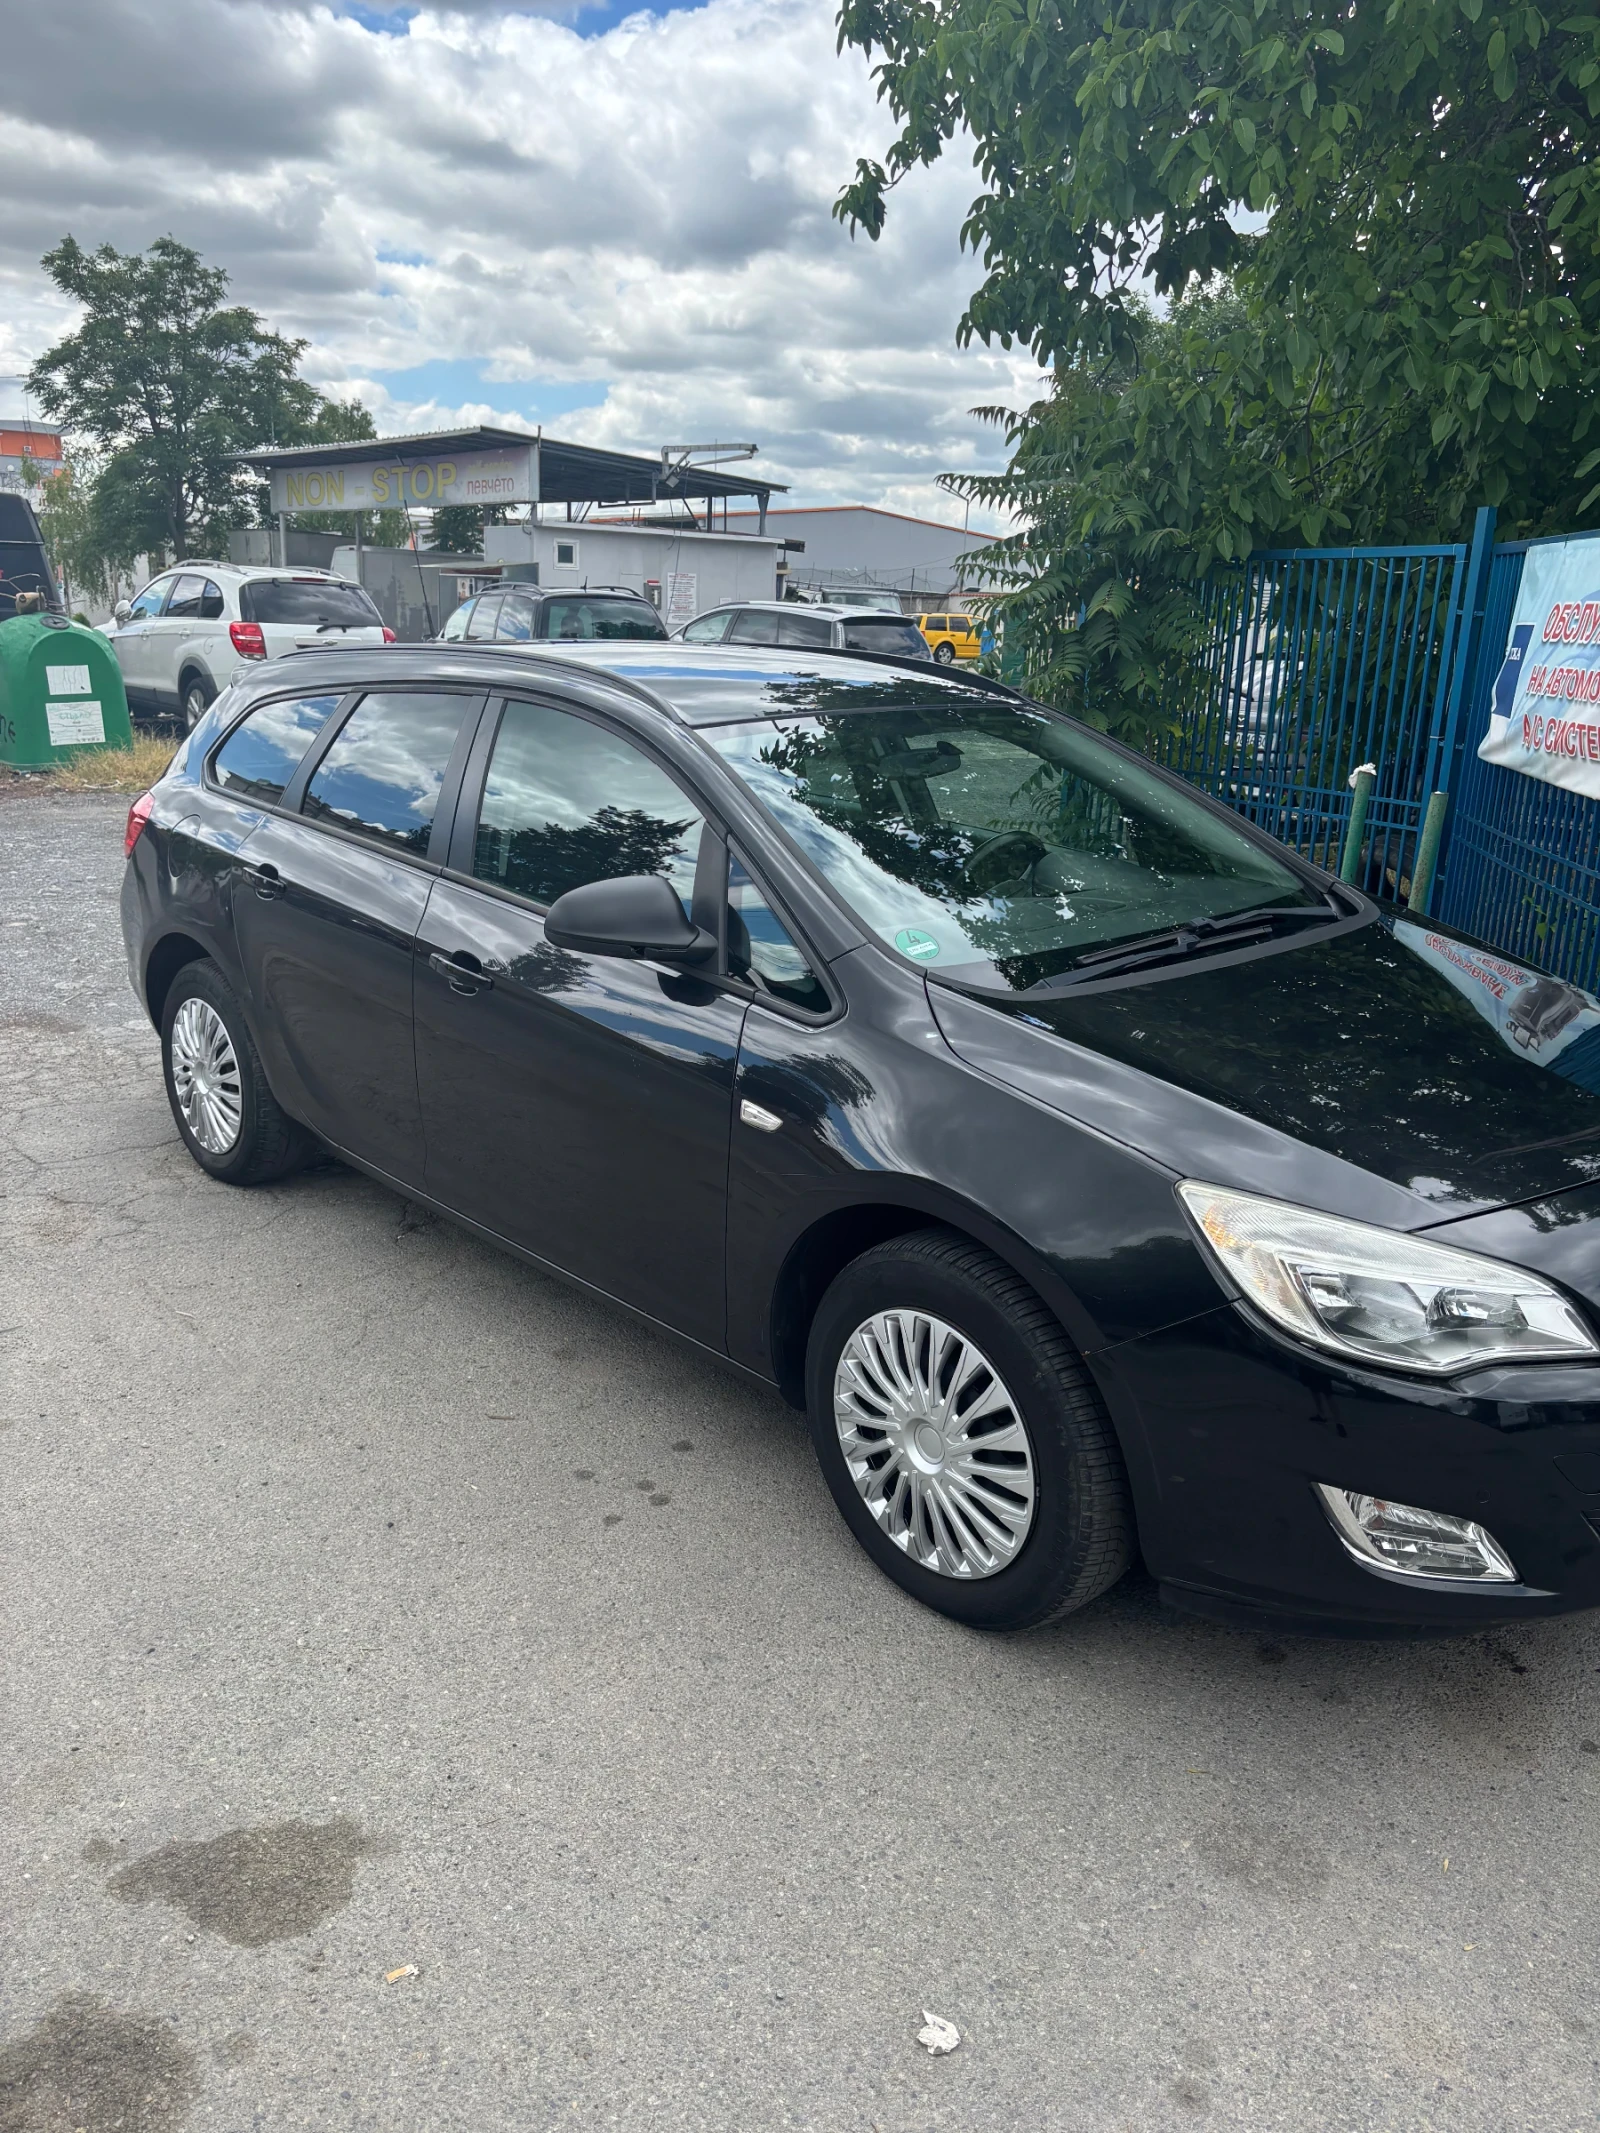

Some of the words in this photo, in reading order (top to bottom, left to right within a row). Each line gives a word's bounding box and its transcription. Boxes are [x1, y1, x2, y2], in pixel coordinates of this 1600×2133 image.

[286, 470, 345, 507] NON
[372, 462, 457, 503] STOP
[1543, 602, 1600, 643] ОБСЛУ
[1527, 666, 1547, 695] НА
[1545, 717, 1600, 760] СИСТЕ
